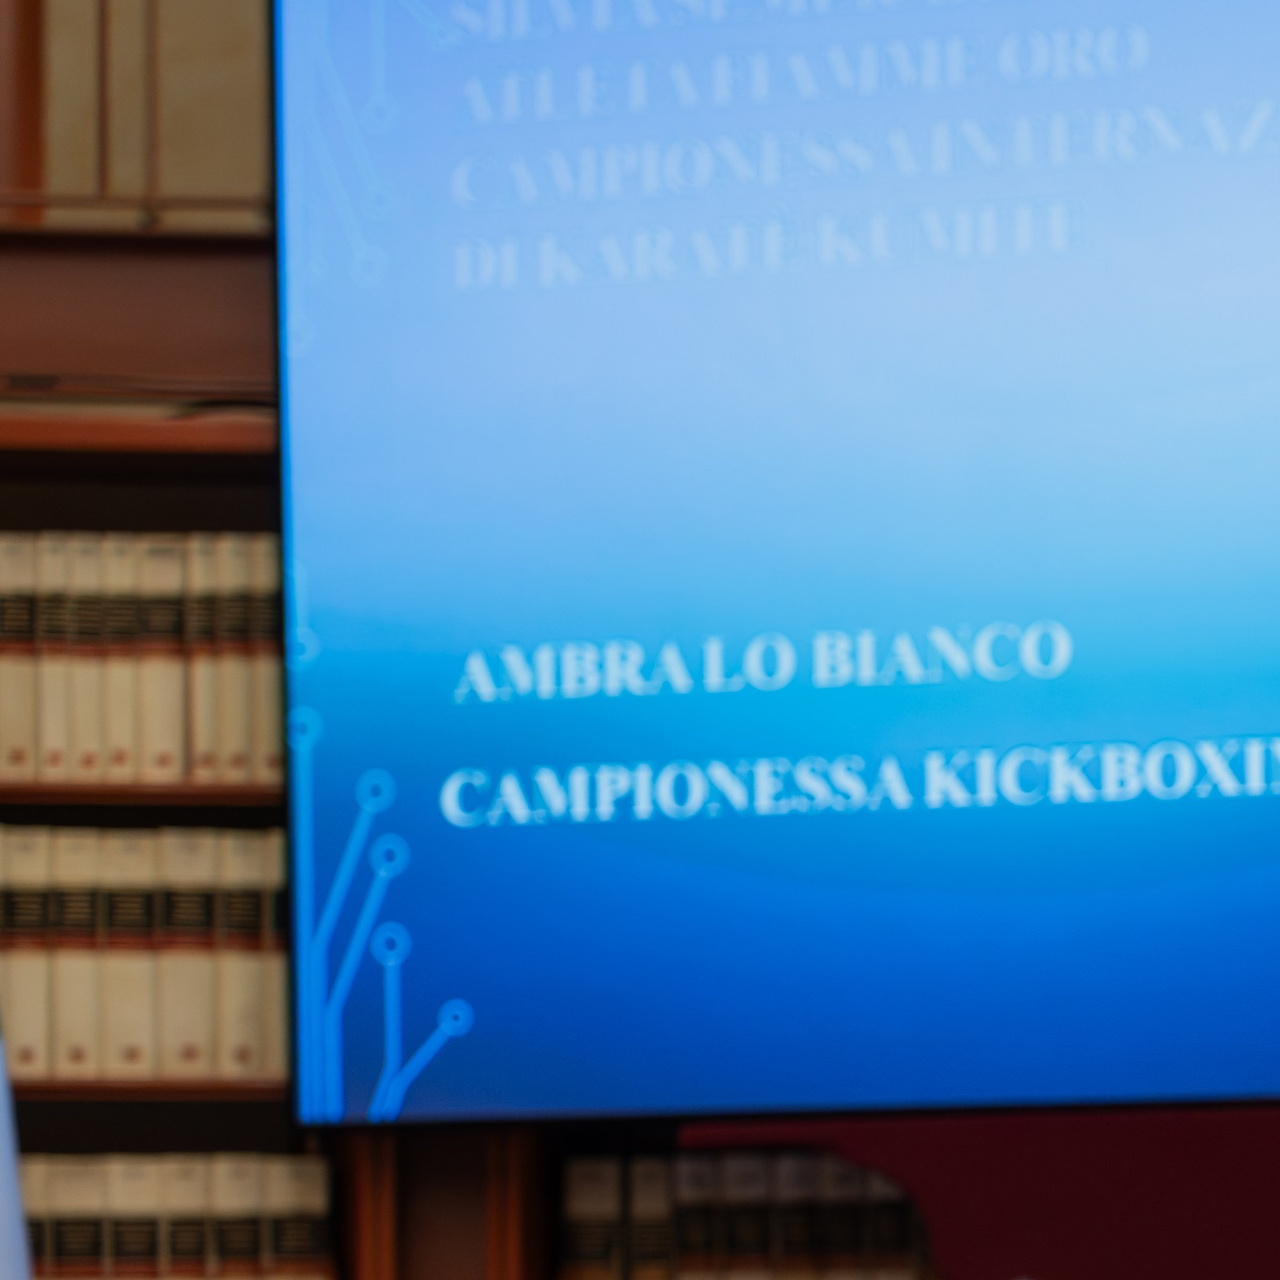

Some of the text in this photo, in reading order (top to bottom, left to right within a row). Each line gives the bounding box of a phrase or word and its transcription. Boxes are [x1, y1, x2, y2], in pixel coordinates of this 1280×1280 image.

[998, 24, 1152, 83] ORO
[448, 127, 918, 211] CAMPIONESSA
[453, 238, 520, 290] DI
[535, 219, 798, 290] KARATE
[454, 618, 1074, 703] AMBRA LO BIANCO
[440, 752, 913, 828] CAMPIONESSA
